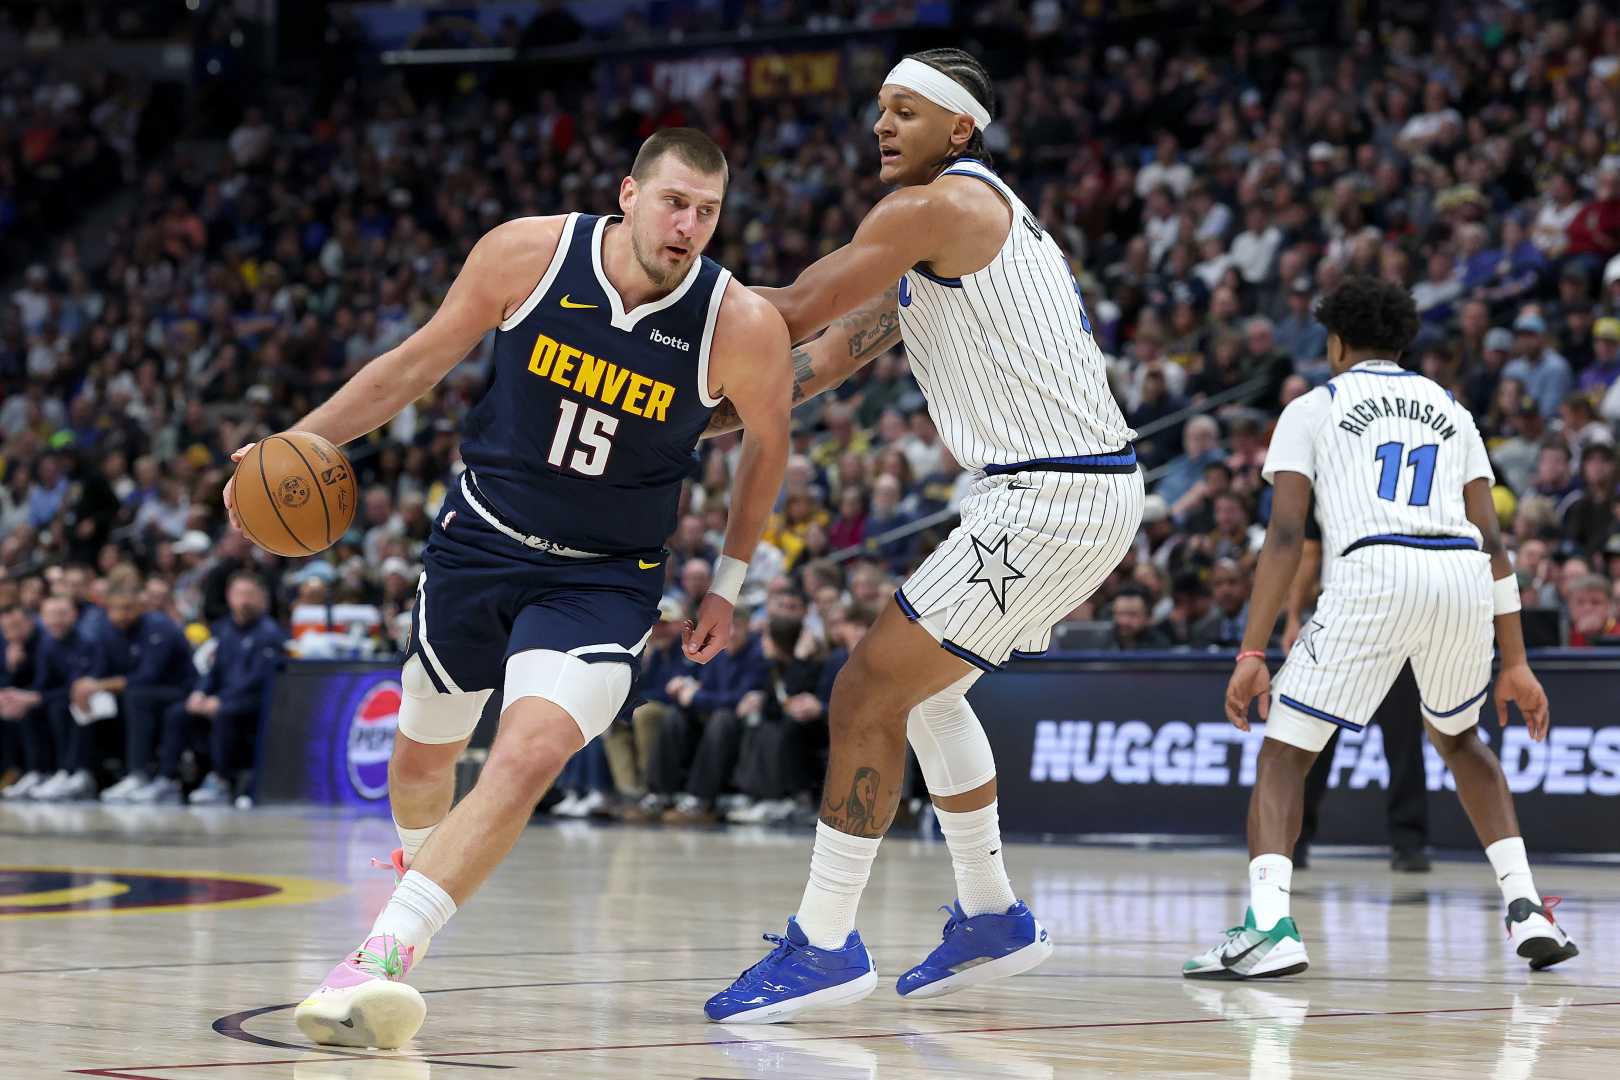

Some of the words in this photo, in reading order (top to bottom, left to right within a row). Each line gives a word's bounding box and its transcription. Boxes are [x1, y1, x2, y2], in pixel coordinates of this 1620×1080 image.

[649, 328, 690, 352] ibotta
[527, 333, 677, 423] DENVER
[547, 398, 620, 476] 15
[1338, 396, 1457, 442] RICHARDSON
[1374, 440, 1440, 507] 11
[1029, 720, 1267, 787] NUGGET
